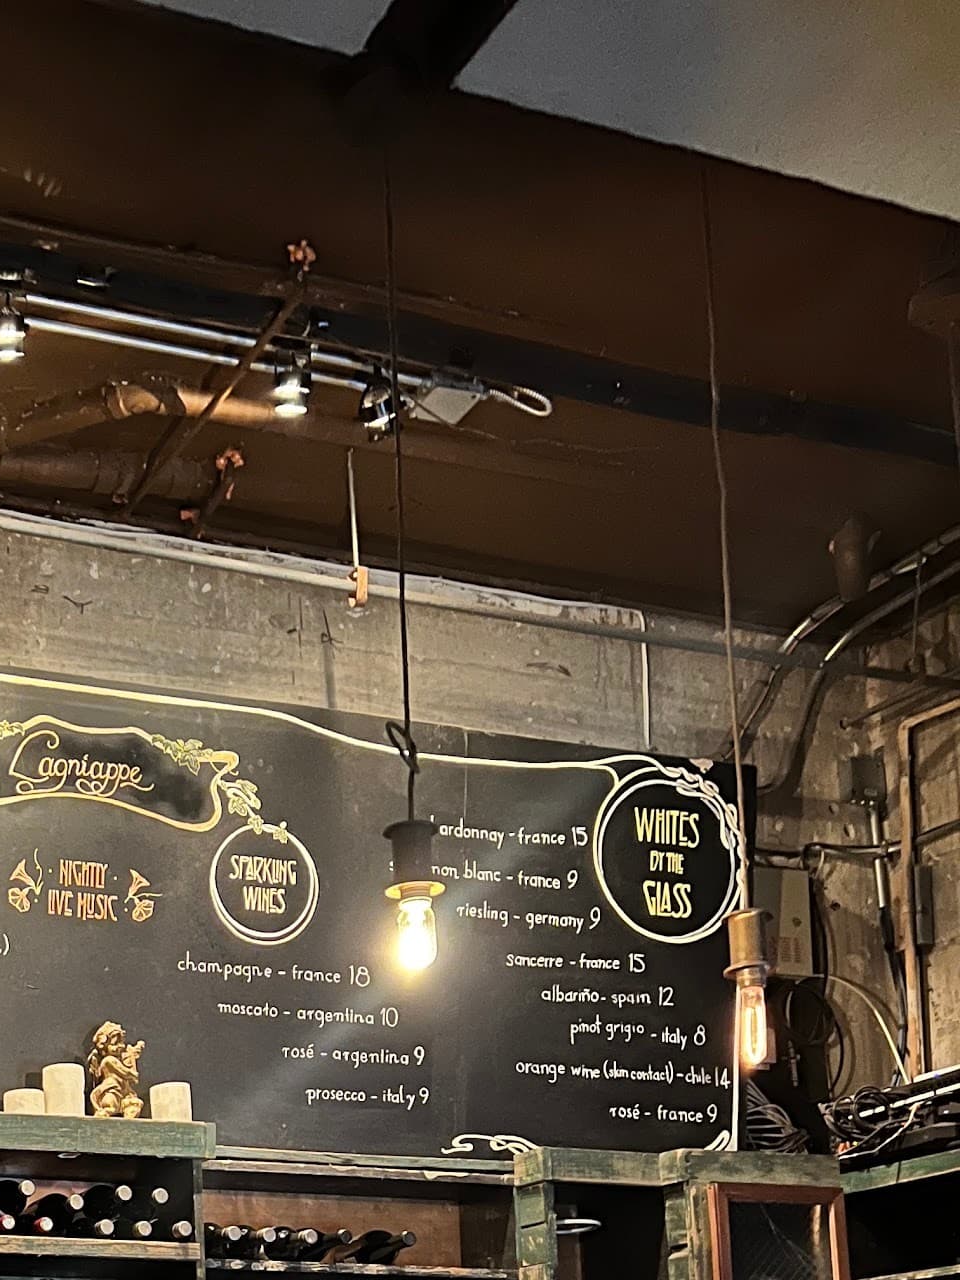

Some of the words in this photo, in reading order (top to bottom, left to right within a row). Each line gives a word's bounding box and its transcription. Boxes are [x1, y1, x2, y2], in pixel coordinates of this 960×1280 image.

[8, 729, 154, 797] Lagniappe
[571, 827, 588, 848] 15
[634, 806, 700, 849] WHITES
[59, 858, 108, 889] NIGHTLY
[229, 854, 298, 886] SPARKLING
[463, 859, 502, 882] blanc
[518, 873, 561, 891] france
[566, 870, 578, 890] 9
[649, 850, 666, 874] BY
[666, 852, 684, 876] THE
[48, 890, 74, 917] LIVE
[77, 892, 118, 922] MUSIC
[242, 886, 287, 914] WINES
[642, 880, 692, 920] GLASS
[456, 900, 509, 927] riesling
[525, 913, 584, 935] germany
[589, 907, 601, 930] 9
[178, 950, 272, 982] champagne
[292, 964, 341, 984] france
[349, 965, 371, 987] 18
[506, 953, 564, 968] sancerre
[579, 953, 621, 971] france
[628, 953, 646, 973] 15
[611, 992, 651, 1008] spain
[658, 986, 674, 1007] 12
[217, 1002, 278, 1018] moscato
[297, 1008, 374, 1028] argentina
[380, 1007, 399, 1028] 10
[570, 1014, 601, 1045] pinot
[605, 1023, 645, 1042] grigio
[661, 1026, 687, 1051] italy
[693, 1024, 706, 1046] 8
[282, 1044, 315, 1059] rosé
[332, 1048, 409, 1068] argentina
[413, 1046, 426, 1066] 9
[516, 1061, 566, 1083] orange
[571, 1065, 601, 1080] wine
[684, 1065, 712, 1085] chile
[715, 1066, 731, 1090] 14
[305, 1088, 366, 1106] prosecco
[382, 1084, 416, 1111] italy
[419, 1087, 430, 1104] 9
[609, 1104, 640, 1120] rosé
[657, 1105, 703, 1123] france
[706, 1104, 718, 1123] 9
